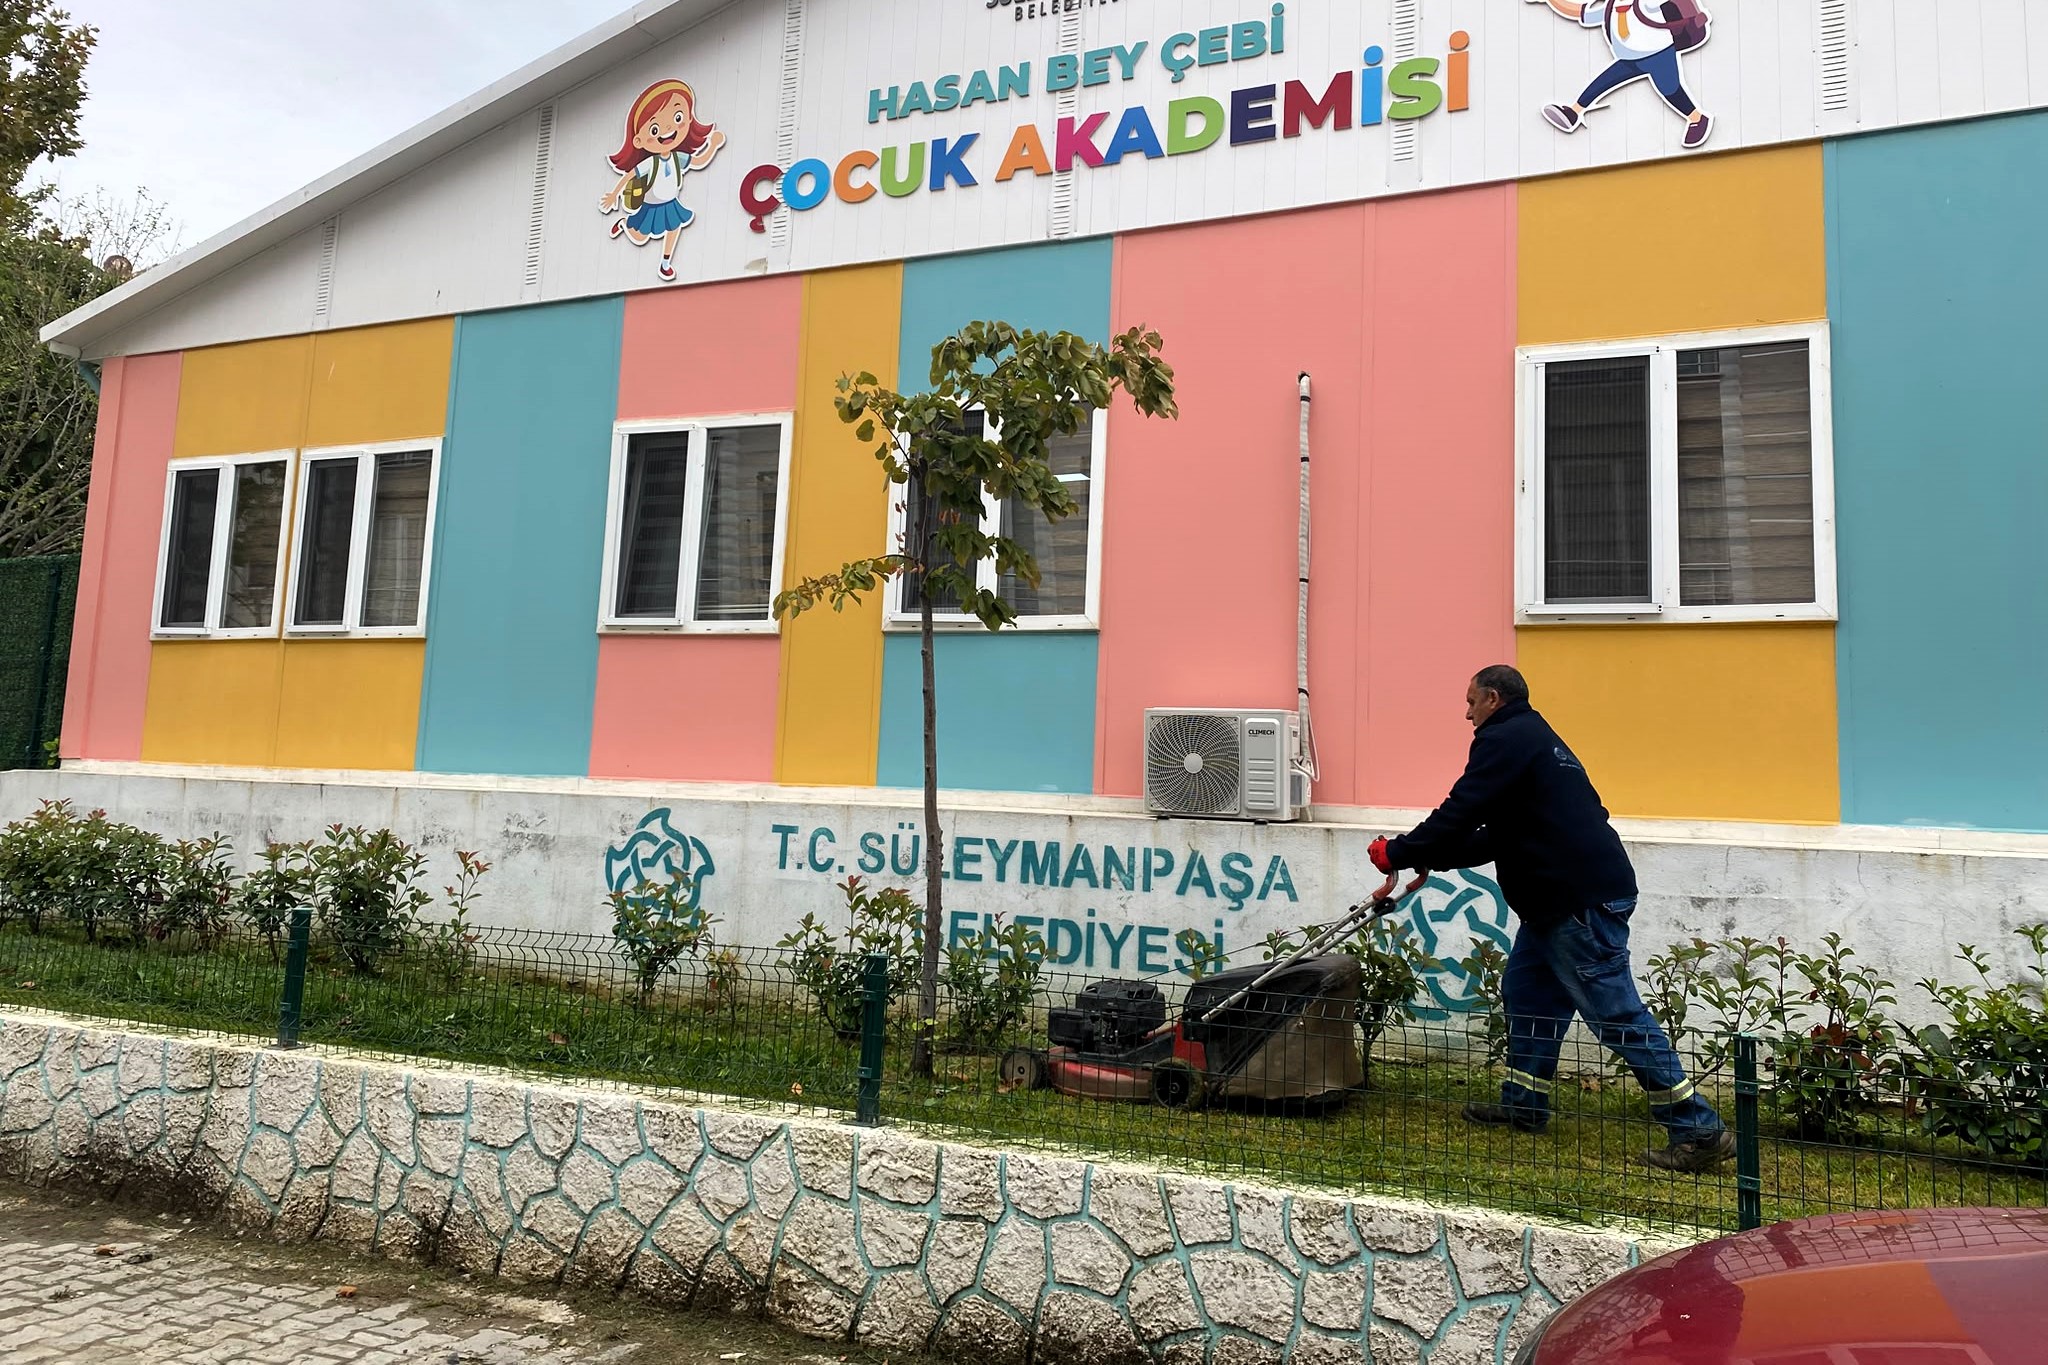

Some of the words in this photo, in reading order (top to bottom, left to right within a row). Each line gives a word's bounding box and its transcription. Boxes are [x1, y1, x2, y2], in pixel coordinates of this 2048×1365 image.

[868, 61, 1030, 123] HASAN
[1046, 41, 1149, 92] BEY
[1160, 3, 1285, 83] ÇEBİ
[739, 133, 979, 233] ÇOCUK
[995, 31, 1470, 182] AKADEMİSİ
[771, 824, 844, 874] T.C.
[857, 822, 1299, 911] SÜEYMANPAŞA
